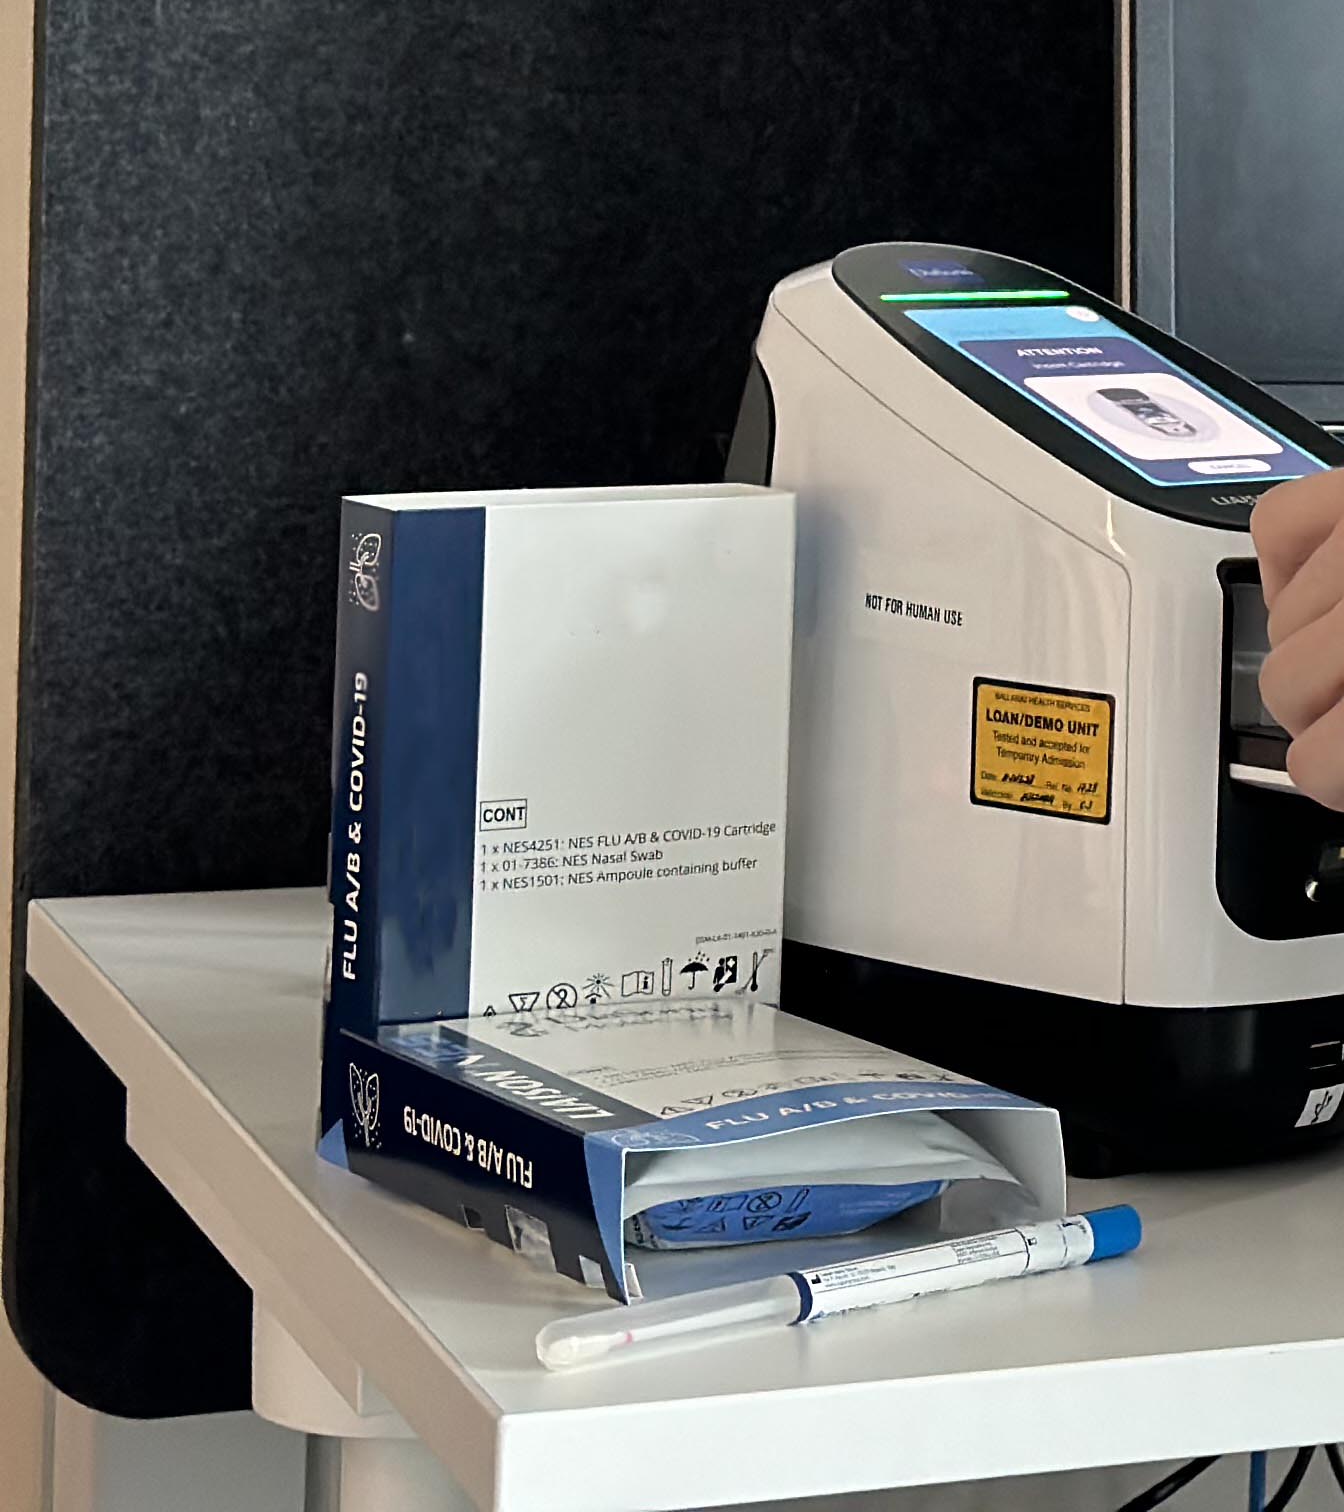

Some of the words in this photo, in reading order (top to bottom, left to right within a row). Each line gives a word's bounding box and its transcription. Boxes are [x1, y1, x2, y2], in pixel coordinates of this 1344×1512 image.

[1016, 346, 1104, 357] ATTENTION
[1211, 495, 1257, 506] LIAIS
[865, 593, 883, 611] NOT
[885, 597, 903, 615] FOR
[906, 601, 940, 622] HUMAN
[943, 609, 962, 626] USE
[986, 708, 1064, 732] LOAN/DEMO
[1067, 720, 1099, 737] UNIT
[349, 671, 367, 812] COVID-19
[993, 730, 1019, 744] Tested
[1021, 734, 1037, 746] and
[1039, 738, 1077, 753] accepted
[1079, 743, 1090, 754] for
[483, 806, 526, 823] CONT
[348, 821, 362, 844] &
[481, 844, 487, 855] 1
[493, 846, 500, 854] x
[503, 839, 564, 854] NES4251:
[568, 836, 594, 849] NES
[597, 834, 621, 847] FLU
[624, 832, 646, 845] A/B
[650, 831, 659, 843] &
[663, 826, 721, 843] COVID-19
[724, 821, 776, 837] Cartridge
[480, 861, 486, 873] 1
[491, 864, 499, 872] x
[562, 854, 587, 867] NES
[591, 851, 626, 865] Nasal
[630, 849, 663, 862] Swab
[480, 879, 486, 890] 1
[492, 881, 500, 890] x
[568, 871, 593, 885] NES
[596, 867, 653, 883] Ampoule
[657, 862, 719, 878] containing
[722, 857, 758, 872] buffer
[345, 852, 361, 913] A/B
[343, 919, 358, 981] FLU
[474, 1069, 615, 1119] LIAISON
[403, 1105, 461, 1156] COVID-19
[705, 1111, 769, 1130] FLU
[779, 1099, 837, 1117] A/B
[464, 1132, 474, 1162] &
[477, 1138, 503, 1175] A/B
[506, 1152, 532, 1189] FLU
